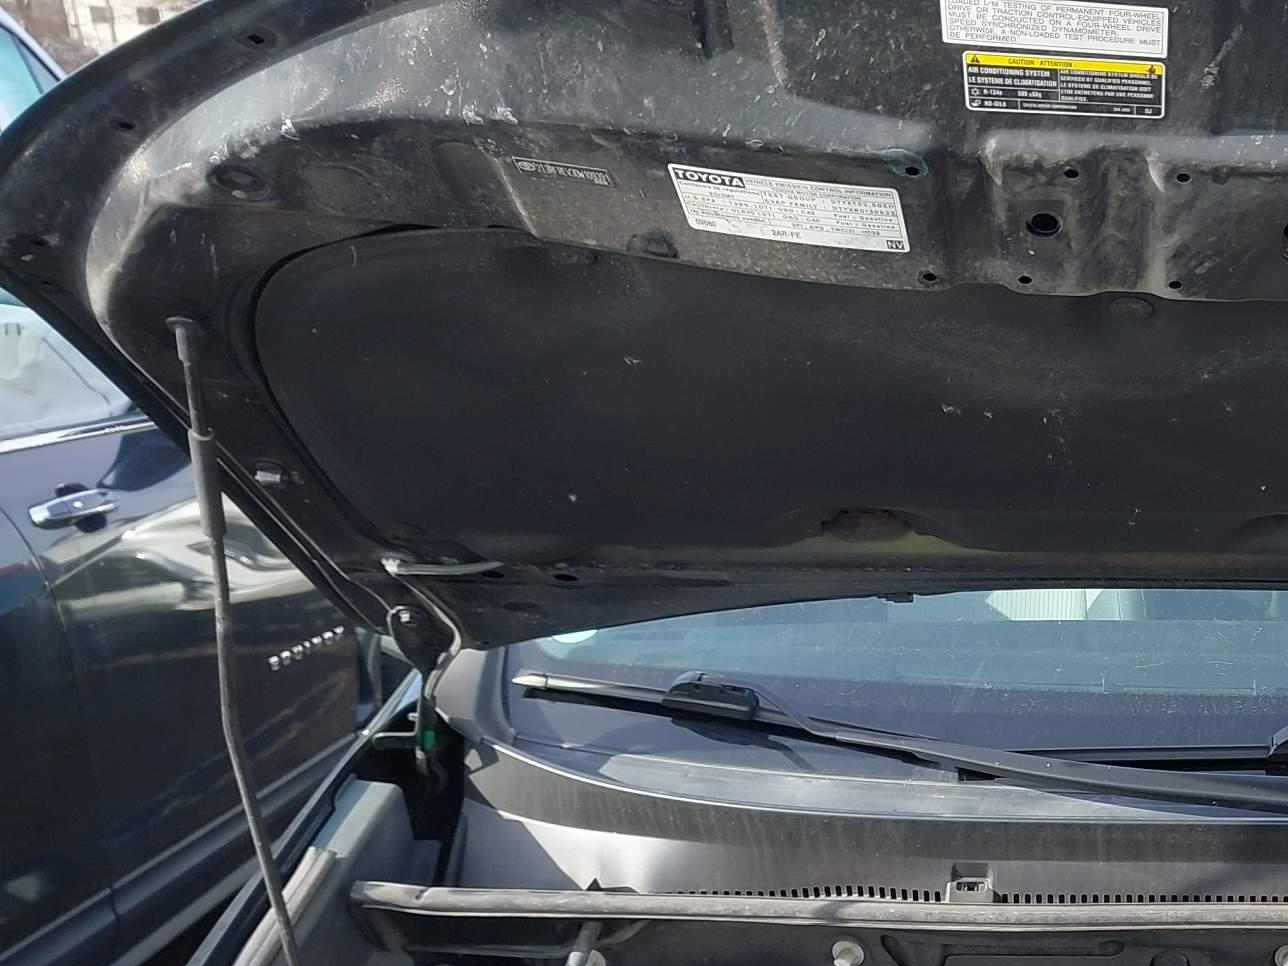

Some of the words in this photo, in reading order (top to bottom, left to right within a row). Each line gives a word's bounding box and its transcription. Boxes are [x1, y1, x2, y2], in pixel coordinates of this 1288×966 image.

[993, 8, 1033, 16] TRACTION
[1036, 11, 1118, 23] CONTROL-EQUIPPED
[1123, 18, 1161, 26] VEHICLES
[1004, 2, 1036, 10] TESTING
[1056, 6, 1104, 16] PERMANENT
[1109, 10, 1160, 19] FOUR-WHEEL
[982, 20, 1047, 31] SYNCHRONIZED
[992, 15, 1044, 24] CONDUCTED
[1077, 21, 1131, 31] FOUR-WHEEL
[1010, 30, 1060, 39] NON-LOADED
[1088, 36, 1136, 44] PROCEDURE
[980, 67, 1024, 76] CONDITIONING
[674, 170, 744, 187] TOYOTA
[771, 229, 801, 239] 2AR-FE
[887, 240, 904, 249] NV
